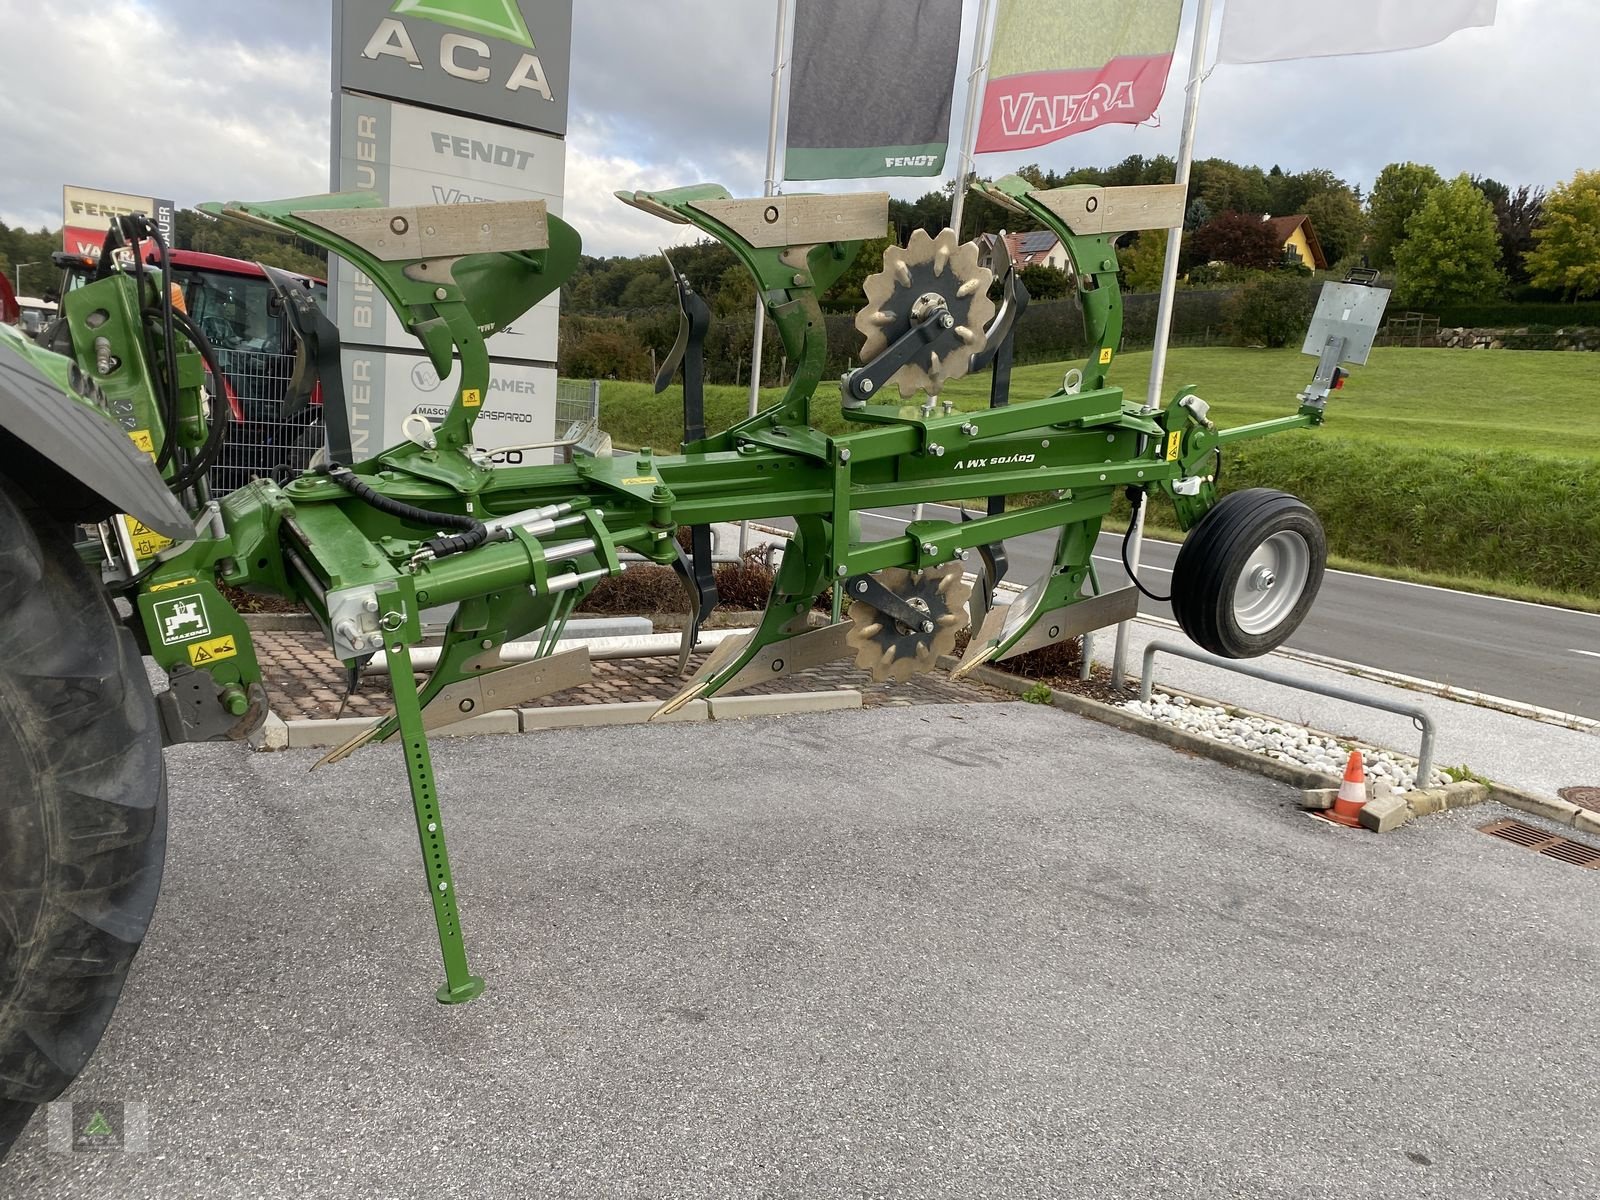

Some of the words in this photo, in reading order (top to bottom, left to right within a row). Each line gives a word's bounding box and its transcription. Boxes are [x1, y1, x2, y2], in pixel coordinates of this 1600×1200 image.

[361, 17, 554, 102] ACA
[1000, 81, 1135, 136] VALTRA
[431, 131, 535, 171] FENDT
[885, 154, 938, 168] FENDT
[953, 460, 964, 470] V
[966, 458, 988, 469] XM
[989, 453, 1036, 465] Cayros
